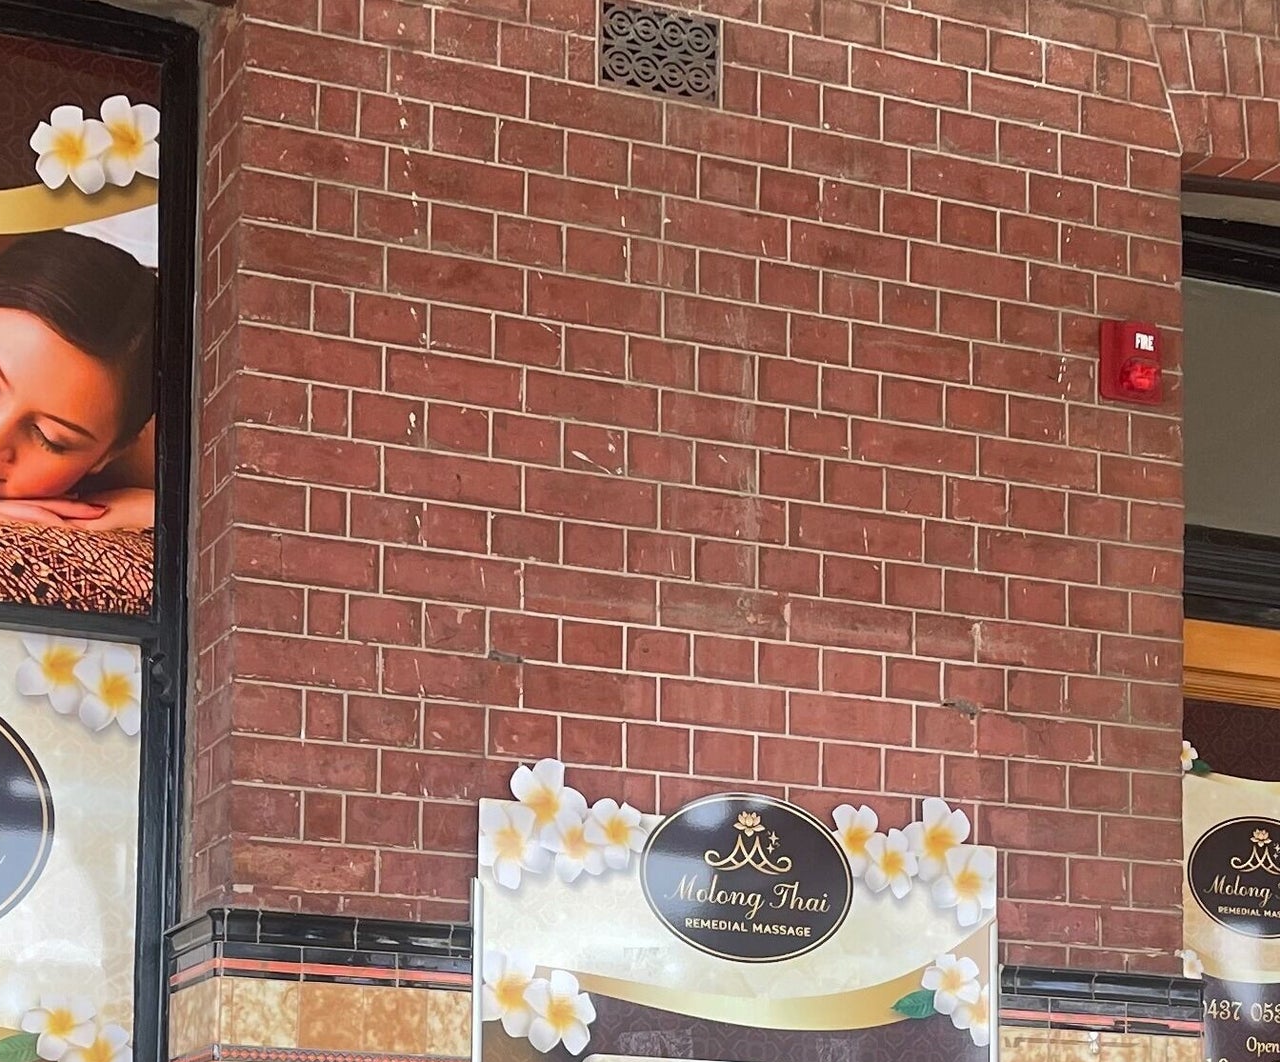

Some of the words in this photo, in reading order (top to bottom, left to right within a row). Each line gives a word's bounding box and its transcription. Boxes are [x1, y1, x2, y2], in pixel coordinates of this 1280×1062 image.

[1135, 332, 1155, 351] FIRE
[664, 874, 765, 920] Molong
[770, 881, 832, 913] Thai
[1203, 874, 1273, 908] Molong
[1217, 905, 1261, 917] REMEDIAL
[685, 917, 749, 933] REMEDIAL
[752, 923, 812, 938] MASSAGE
[1246, 1036, 1280, 1058] Open
